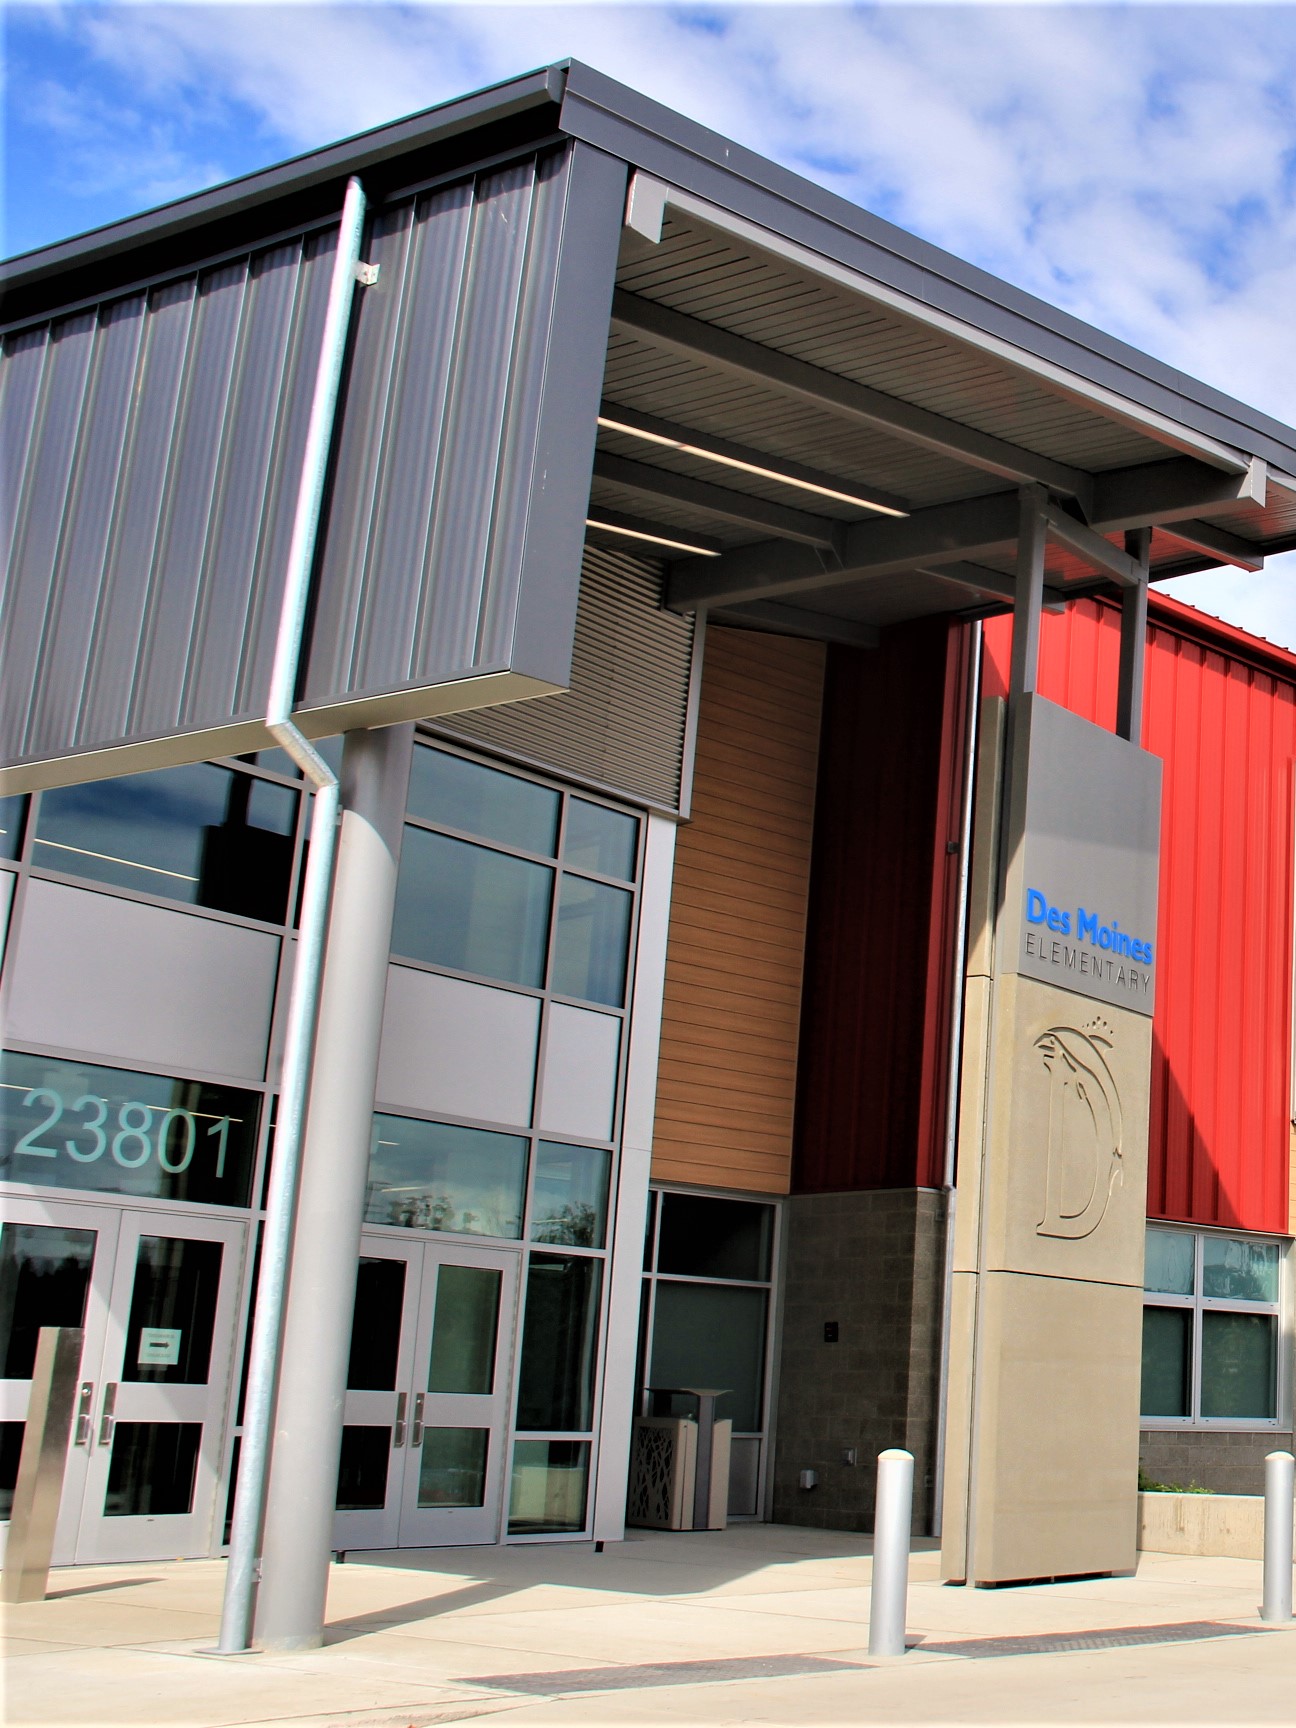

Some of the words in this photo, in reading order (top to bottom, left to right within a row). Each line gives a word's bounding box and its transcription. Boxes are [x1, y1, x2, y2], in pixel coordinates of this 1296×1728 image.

[1025, 932, 1151, 994] ELEMENTARY
[1026, 887, 1072, 935] Des
[1077, 907, 1153, 965] Moines
[13, 1087, 230, 1178] 23801
